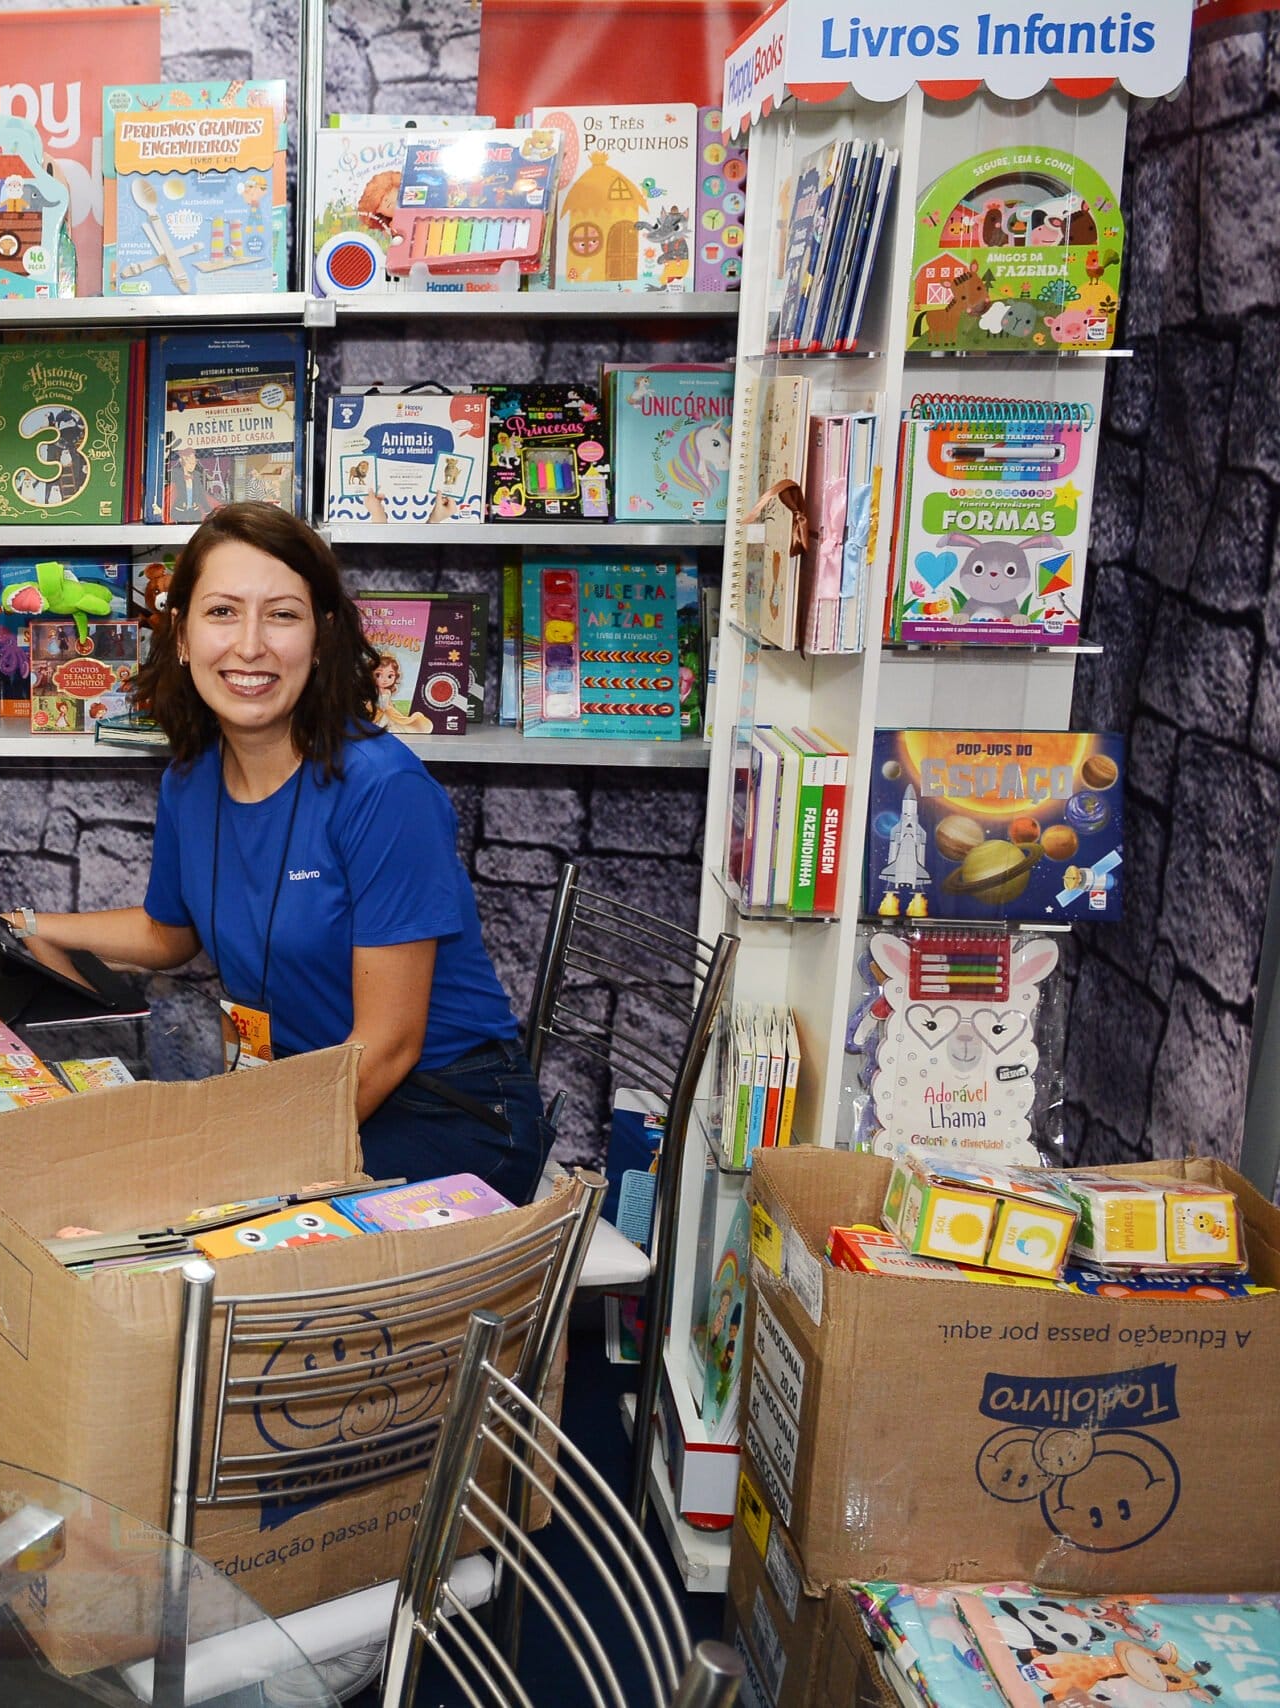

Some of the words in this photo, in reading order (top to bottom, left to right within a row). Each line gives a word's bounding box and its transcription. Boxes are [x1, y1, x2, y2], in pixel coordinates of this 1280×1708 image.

[820, 16, 960, 60] Livros
[977, 12, 1156, 56] Infantis
[123, 121, 195, 139] PEQUENOS
[199, 119, 262, 137] GRANDES
[141, 139, 240, 157] ENGENHEIROS
[973, 157, 1010, 177] SEGURE,
[1013, 155, 1032, 164] LEIA
[1035, 156, 1041, 164] &
[1045, 158, 1075, 176] CONTE
[29, 251, 44, 263] 46
[987, 253, 1027, 263] AMIGOS
[1030, 253, 1043, 261] DA
[995, 265, 1069, 277] FAZENDA
[27, 363, 87, 388] Histórias
[188, 418, 234, 436] ARSÈNE
[240, 416, 273, 431] LUPIN
[529, 411, 563, 420] NEON
[506, 416, 585, 438] Princesas
[976, 434, 994, 442] ALÇA
[1006, 434, 1054, 442] TRANSPORTE
[196, 435, 228, 446] LADRÃO
[231, 434, 241, 442] DE
[245, 431, 276, 441] CASACA
[382, 432, 433, 447] Animais
[12, 403, 91, 508] 3
[381, 447, 395, 456] Jogo
[397, 447, 405, 455] da
[406, 447, 433, 455] Memória
[942, 510, 1057, 532] FORMAS
[584, 583, 666, 600] PULSEIRA
[587, 612, 664, 628] AMIZADE
[597, 632, 614, 640] LIVRO
[623, 633, 657, 641] ATIVIDADES
[956, 743, 1012, 756] POP-UPS
[1015, 744, 1033, 756] DO
[920, 758, 1073, 804] ESPAÇO
[799, 807, 816, 887] FAZENDINHA
[821, 808, 838, 874] SELVAGEM
[924, 1081, 989, 1104] Adorável
[930, 1103, 986, 1129] Lhama
[911, 1134, 949, 1145] Colorir
[960, 1139, 1004, 1150] divertido!
[934, 1214, 946, 1234] SOL
[1124, 1200, 1136, 1250] AMARELO
[1176, 1206, 1187, 1251] AMARELO
[1006, 1227, 1018, 1246] LUA
[757, 1300, 802, 1385] PROMOCIONAL
[938, 1321, 992, 1344] aqui.
[1000, 1322, 1039, 1343] por
[1048, 1323, 1110, 1345] passa
[1119, 1325, 1227, 1349] Educação
[1236, 1329, 1252, 1345] A
[780, 1370, 798, 1410] 20,00
[752, 1365, 796, 1451] PROMOCIONAL
[990, 1381, 1168, 1422] Todolivro
[773, 1437, 791, 1478] 25,00
[747, 1428, 790, 1523] PROMOCIONAL
[214, 1537, 314, 1576] Educação
[321, 1516, 379, 1551] passa
[385, 1502, 421, 1532] por
